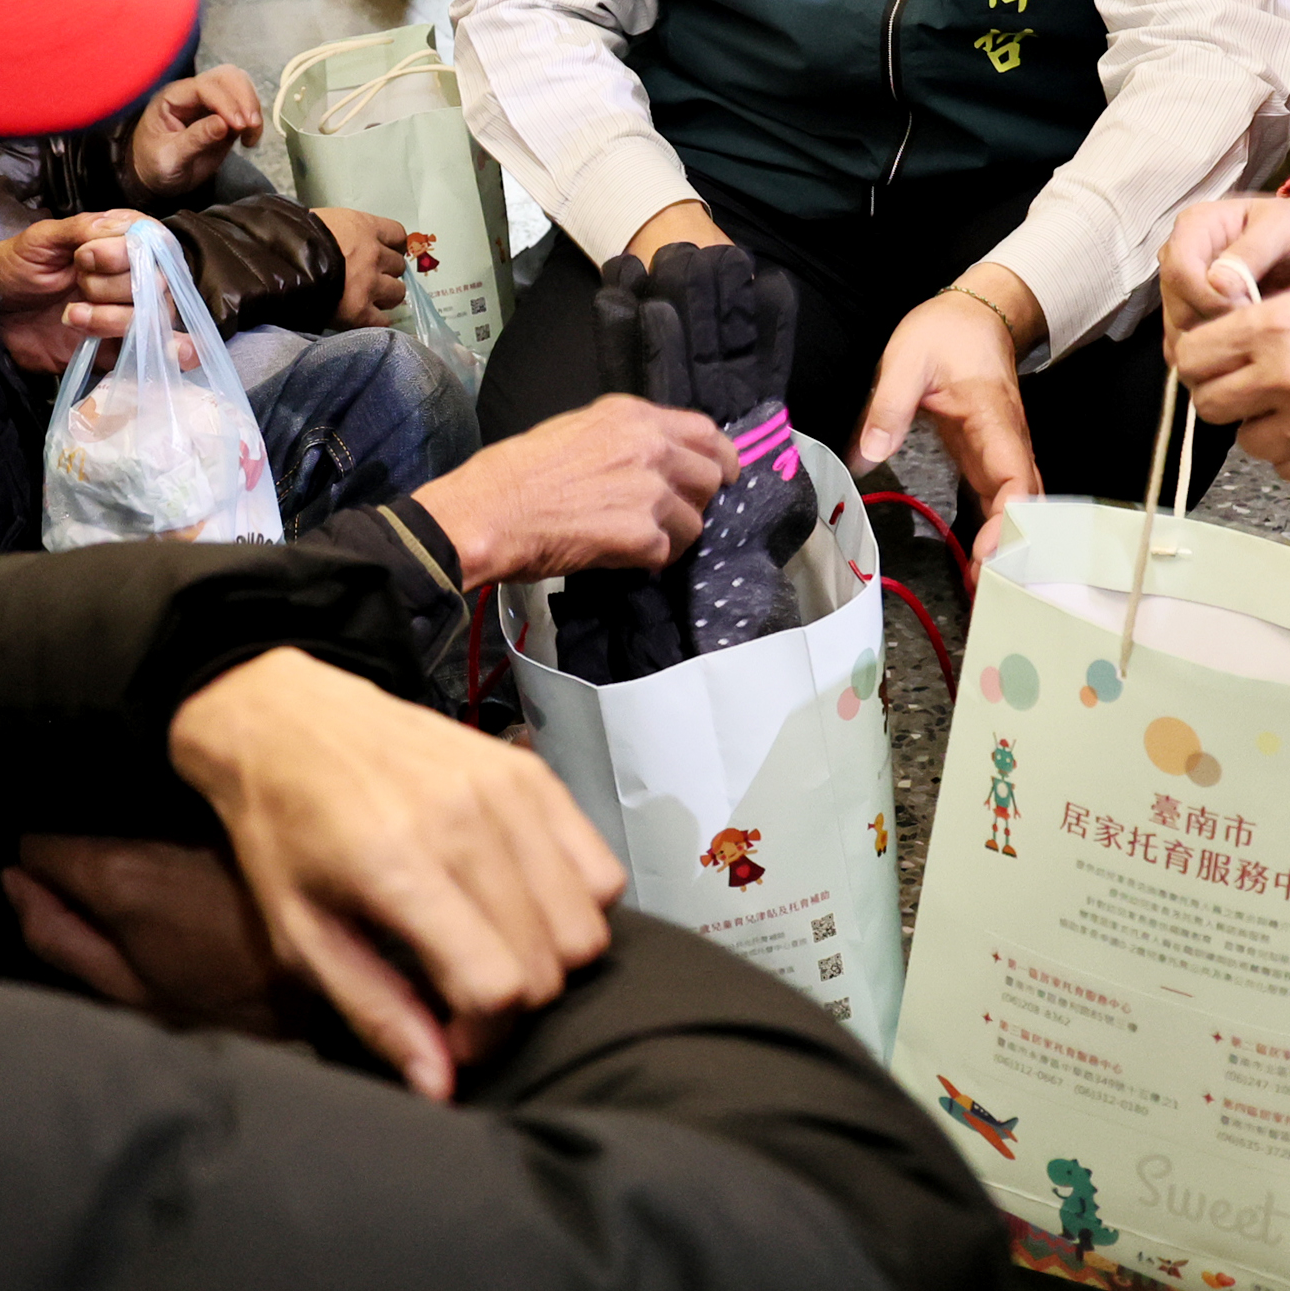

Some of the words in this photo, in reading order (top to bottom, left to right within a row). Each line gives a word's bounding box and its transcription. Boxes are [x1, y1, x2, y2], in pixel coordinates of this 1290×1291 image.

[1149, 791, 1258, 849] 臺南市
[1135, 1152, 1290, 1248] Sweet
